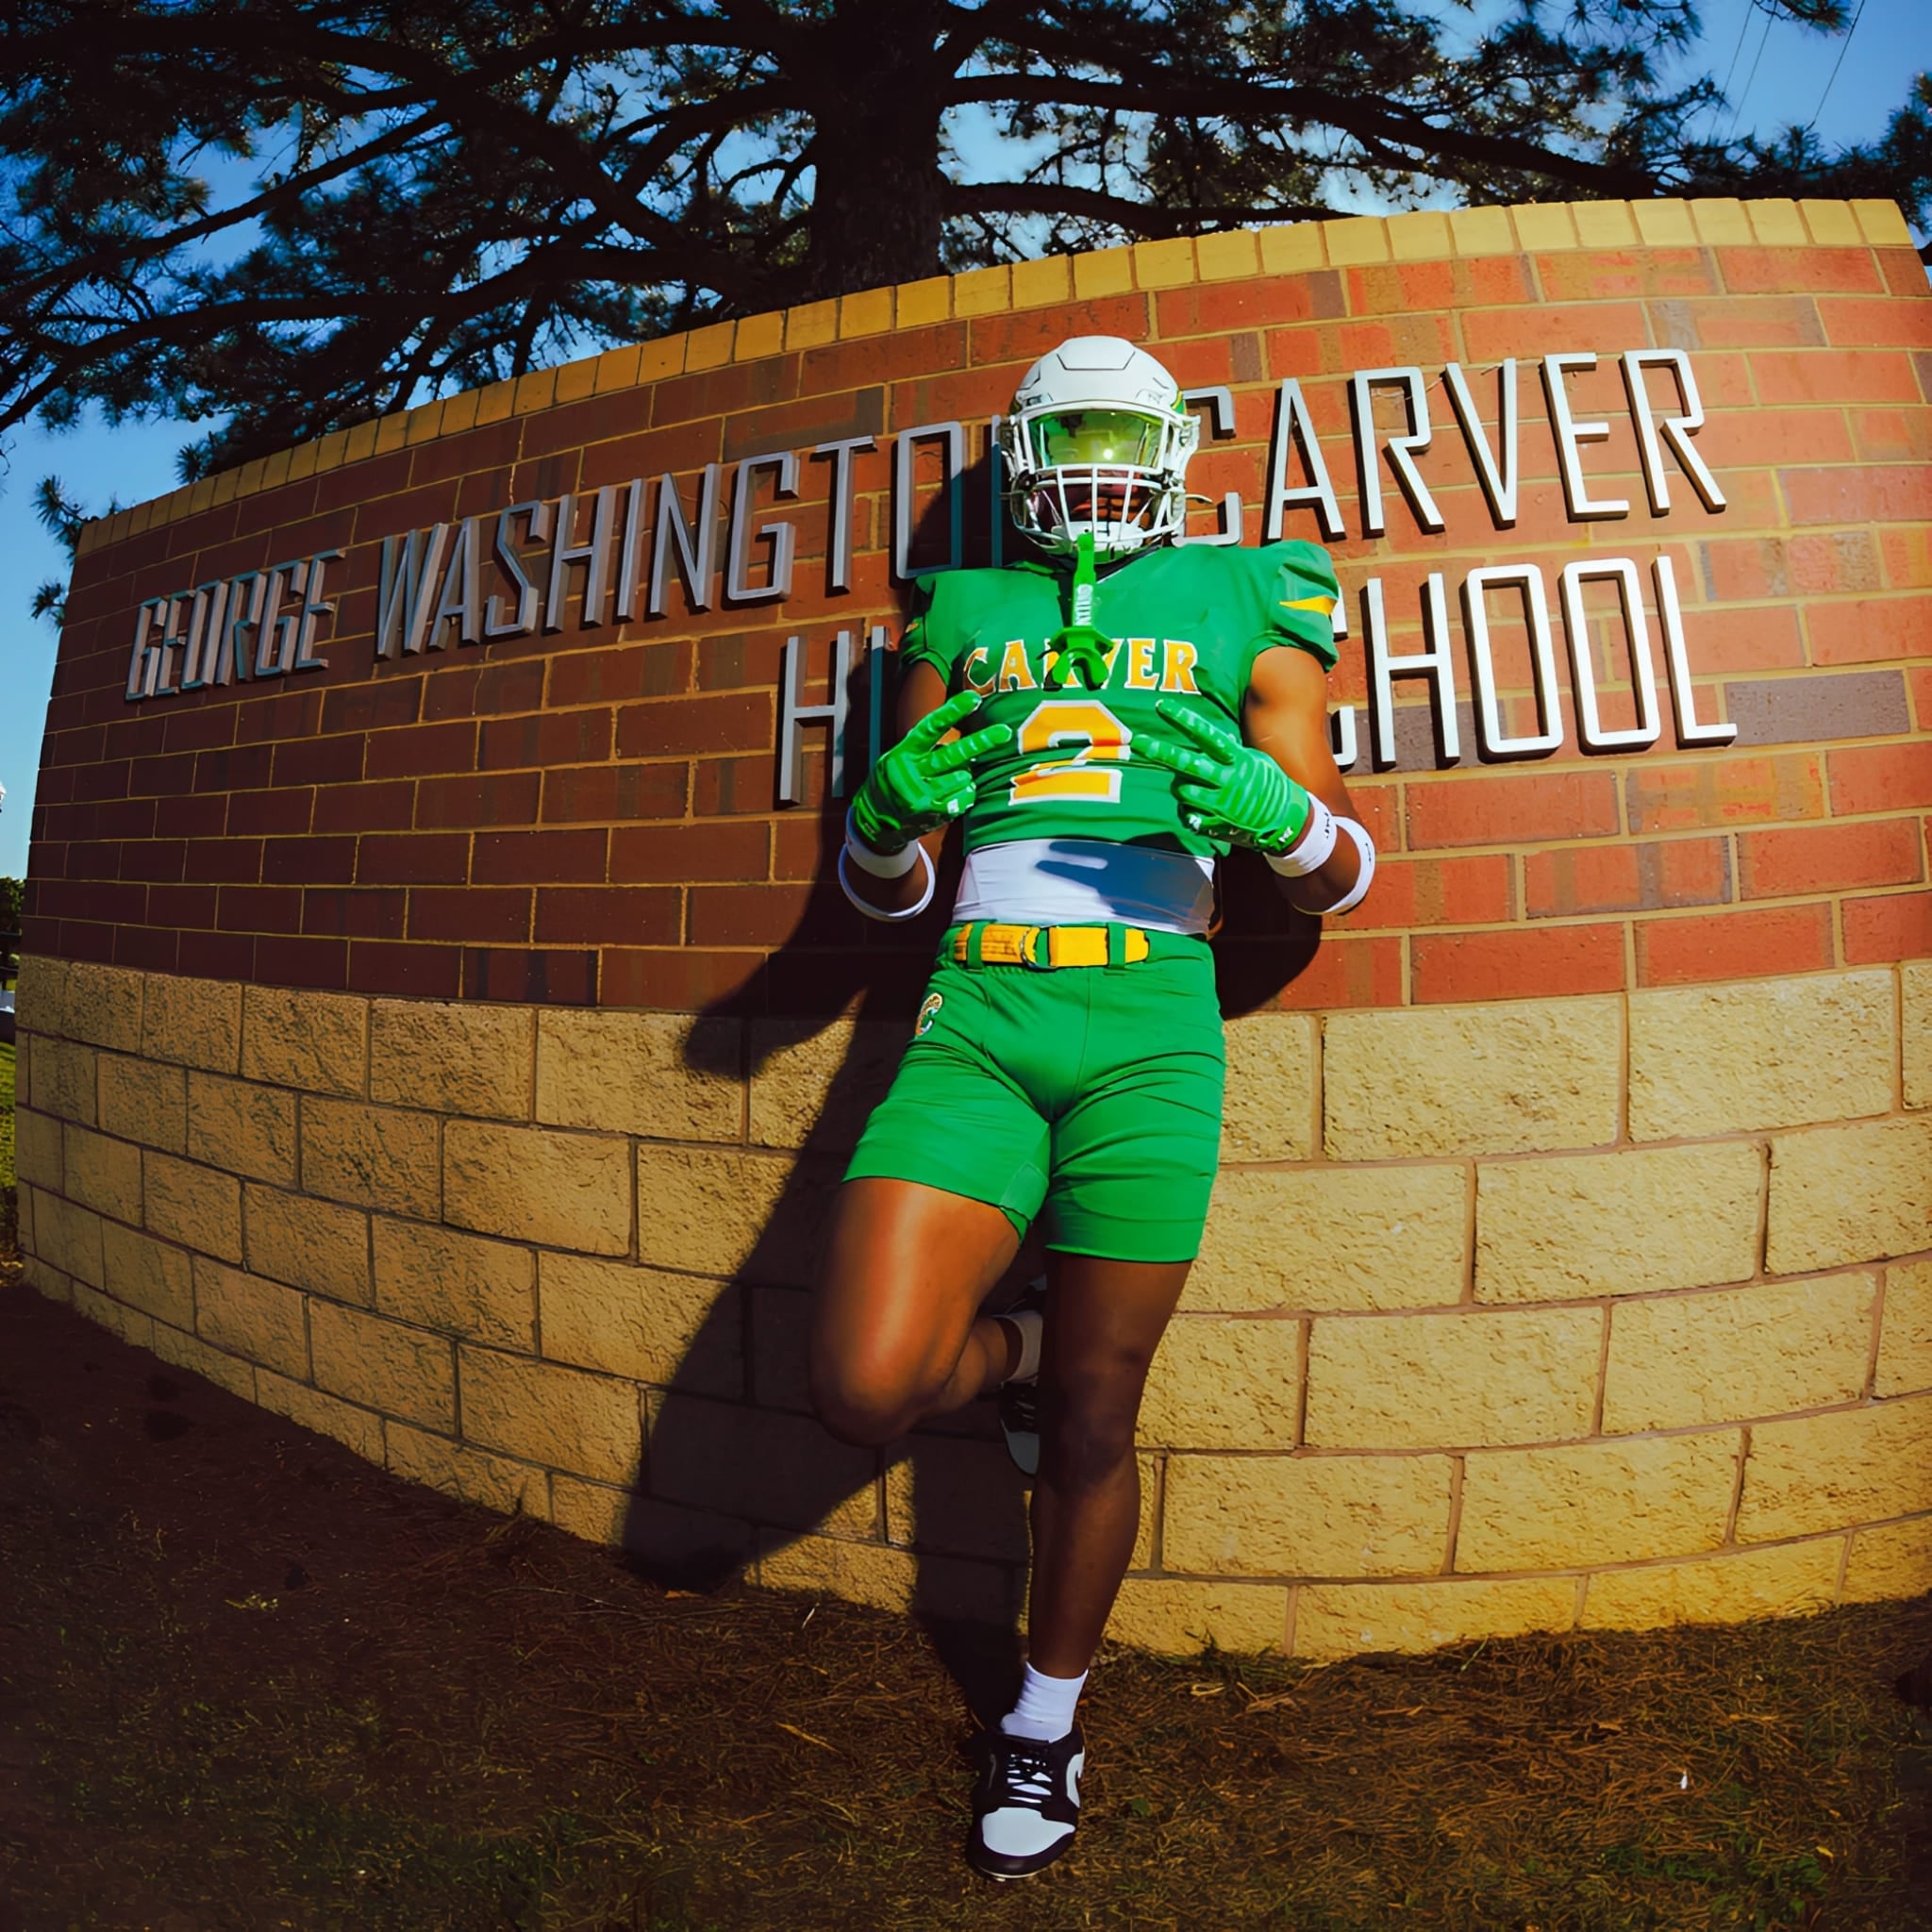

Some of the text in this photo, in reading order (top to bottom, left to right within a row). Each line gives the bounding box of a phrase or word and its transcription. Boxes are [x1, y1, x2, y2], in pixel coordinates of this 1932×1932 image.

[125, 548, 346, 701] GEORGE
[376, 415, 1002, 659] WASHINGTO
[1008, 699, 1133, 807] 2
